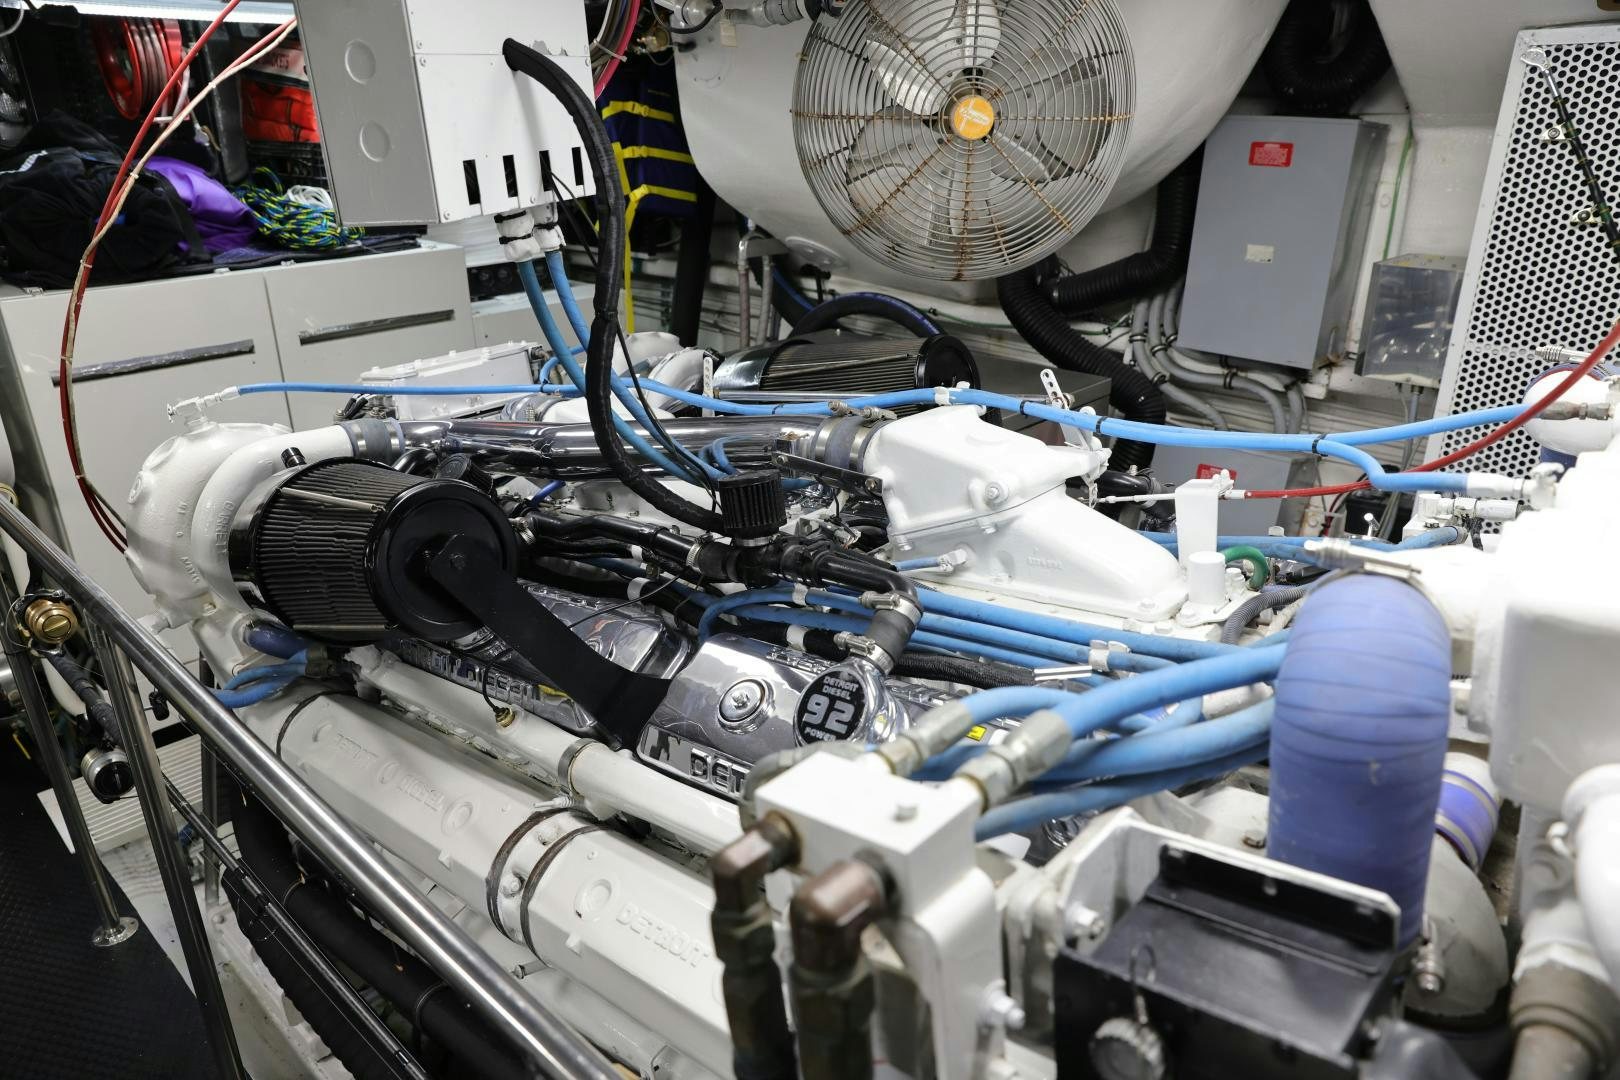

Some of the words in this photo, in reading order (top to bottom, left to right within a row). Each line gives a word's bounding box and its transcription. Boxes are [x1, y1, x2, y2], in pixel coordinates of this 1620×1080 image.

[822, 685, 851, 700] DIESEL
[823, 675, 859, 692] DETROIT
[803, 693, 855, 734] 92
[690, 747, 751, 798] DET
